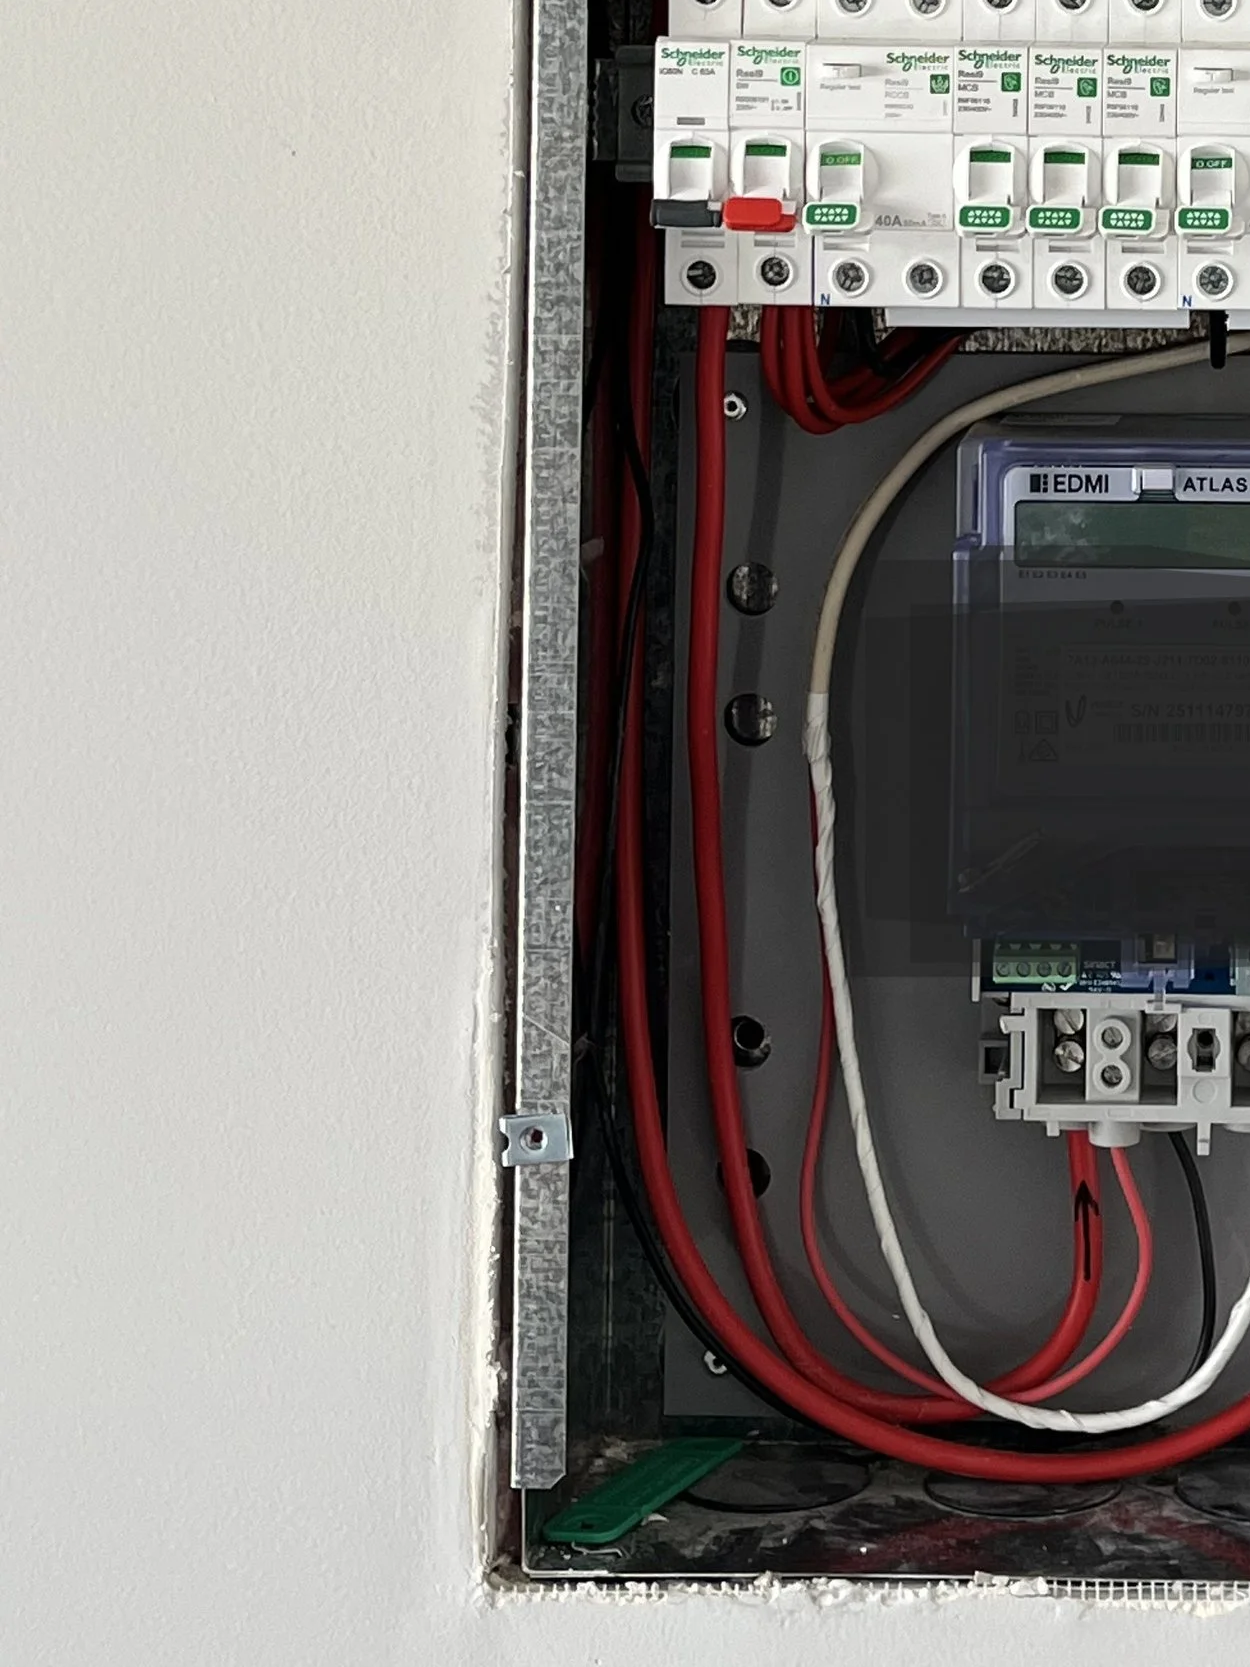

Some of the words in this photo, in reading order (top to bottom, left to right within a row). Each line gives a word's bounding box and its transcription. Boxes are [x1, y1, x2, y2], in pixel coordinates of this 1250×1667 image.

[661, 48, 726, 67] Schneider
[737, 46, 801, 64] Schneider
[886, 52, 950, 71] Schneider
[958, 50, 1022, 69] Schneider
[1034, 54, 1098, 74] Schneider
[1107, 54, 1171, 74] Schneider
[875, 214, 902, 227] 40A
[821, 293, 831, 305] N
[1182, 295, 1192, 307] N
[1053, 474, 1110, 494] EDMI
[1183, 477, 1248, 493] ATLAS
